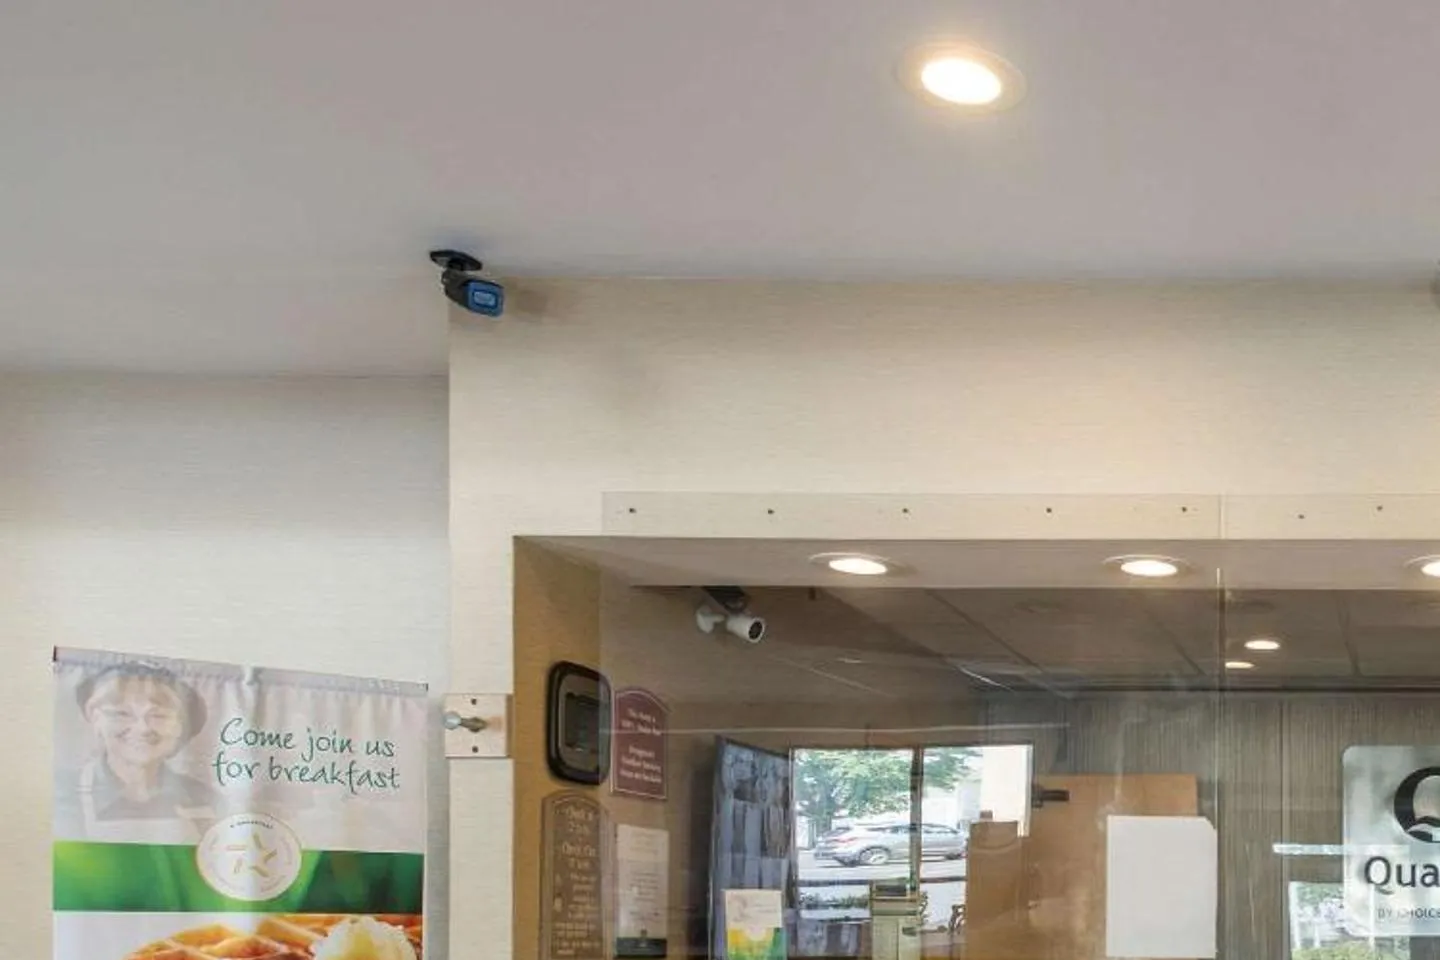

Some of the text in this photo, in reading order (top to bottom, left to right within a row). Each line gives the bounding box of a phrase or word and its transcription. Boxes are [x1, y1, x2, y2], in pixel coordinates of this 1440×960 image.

[220, 717, 396, 762] Come join us
[212, 754, 401, 795] for breakfast
